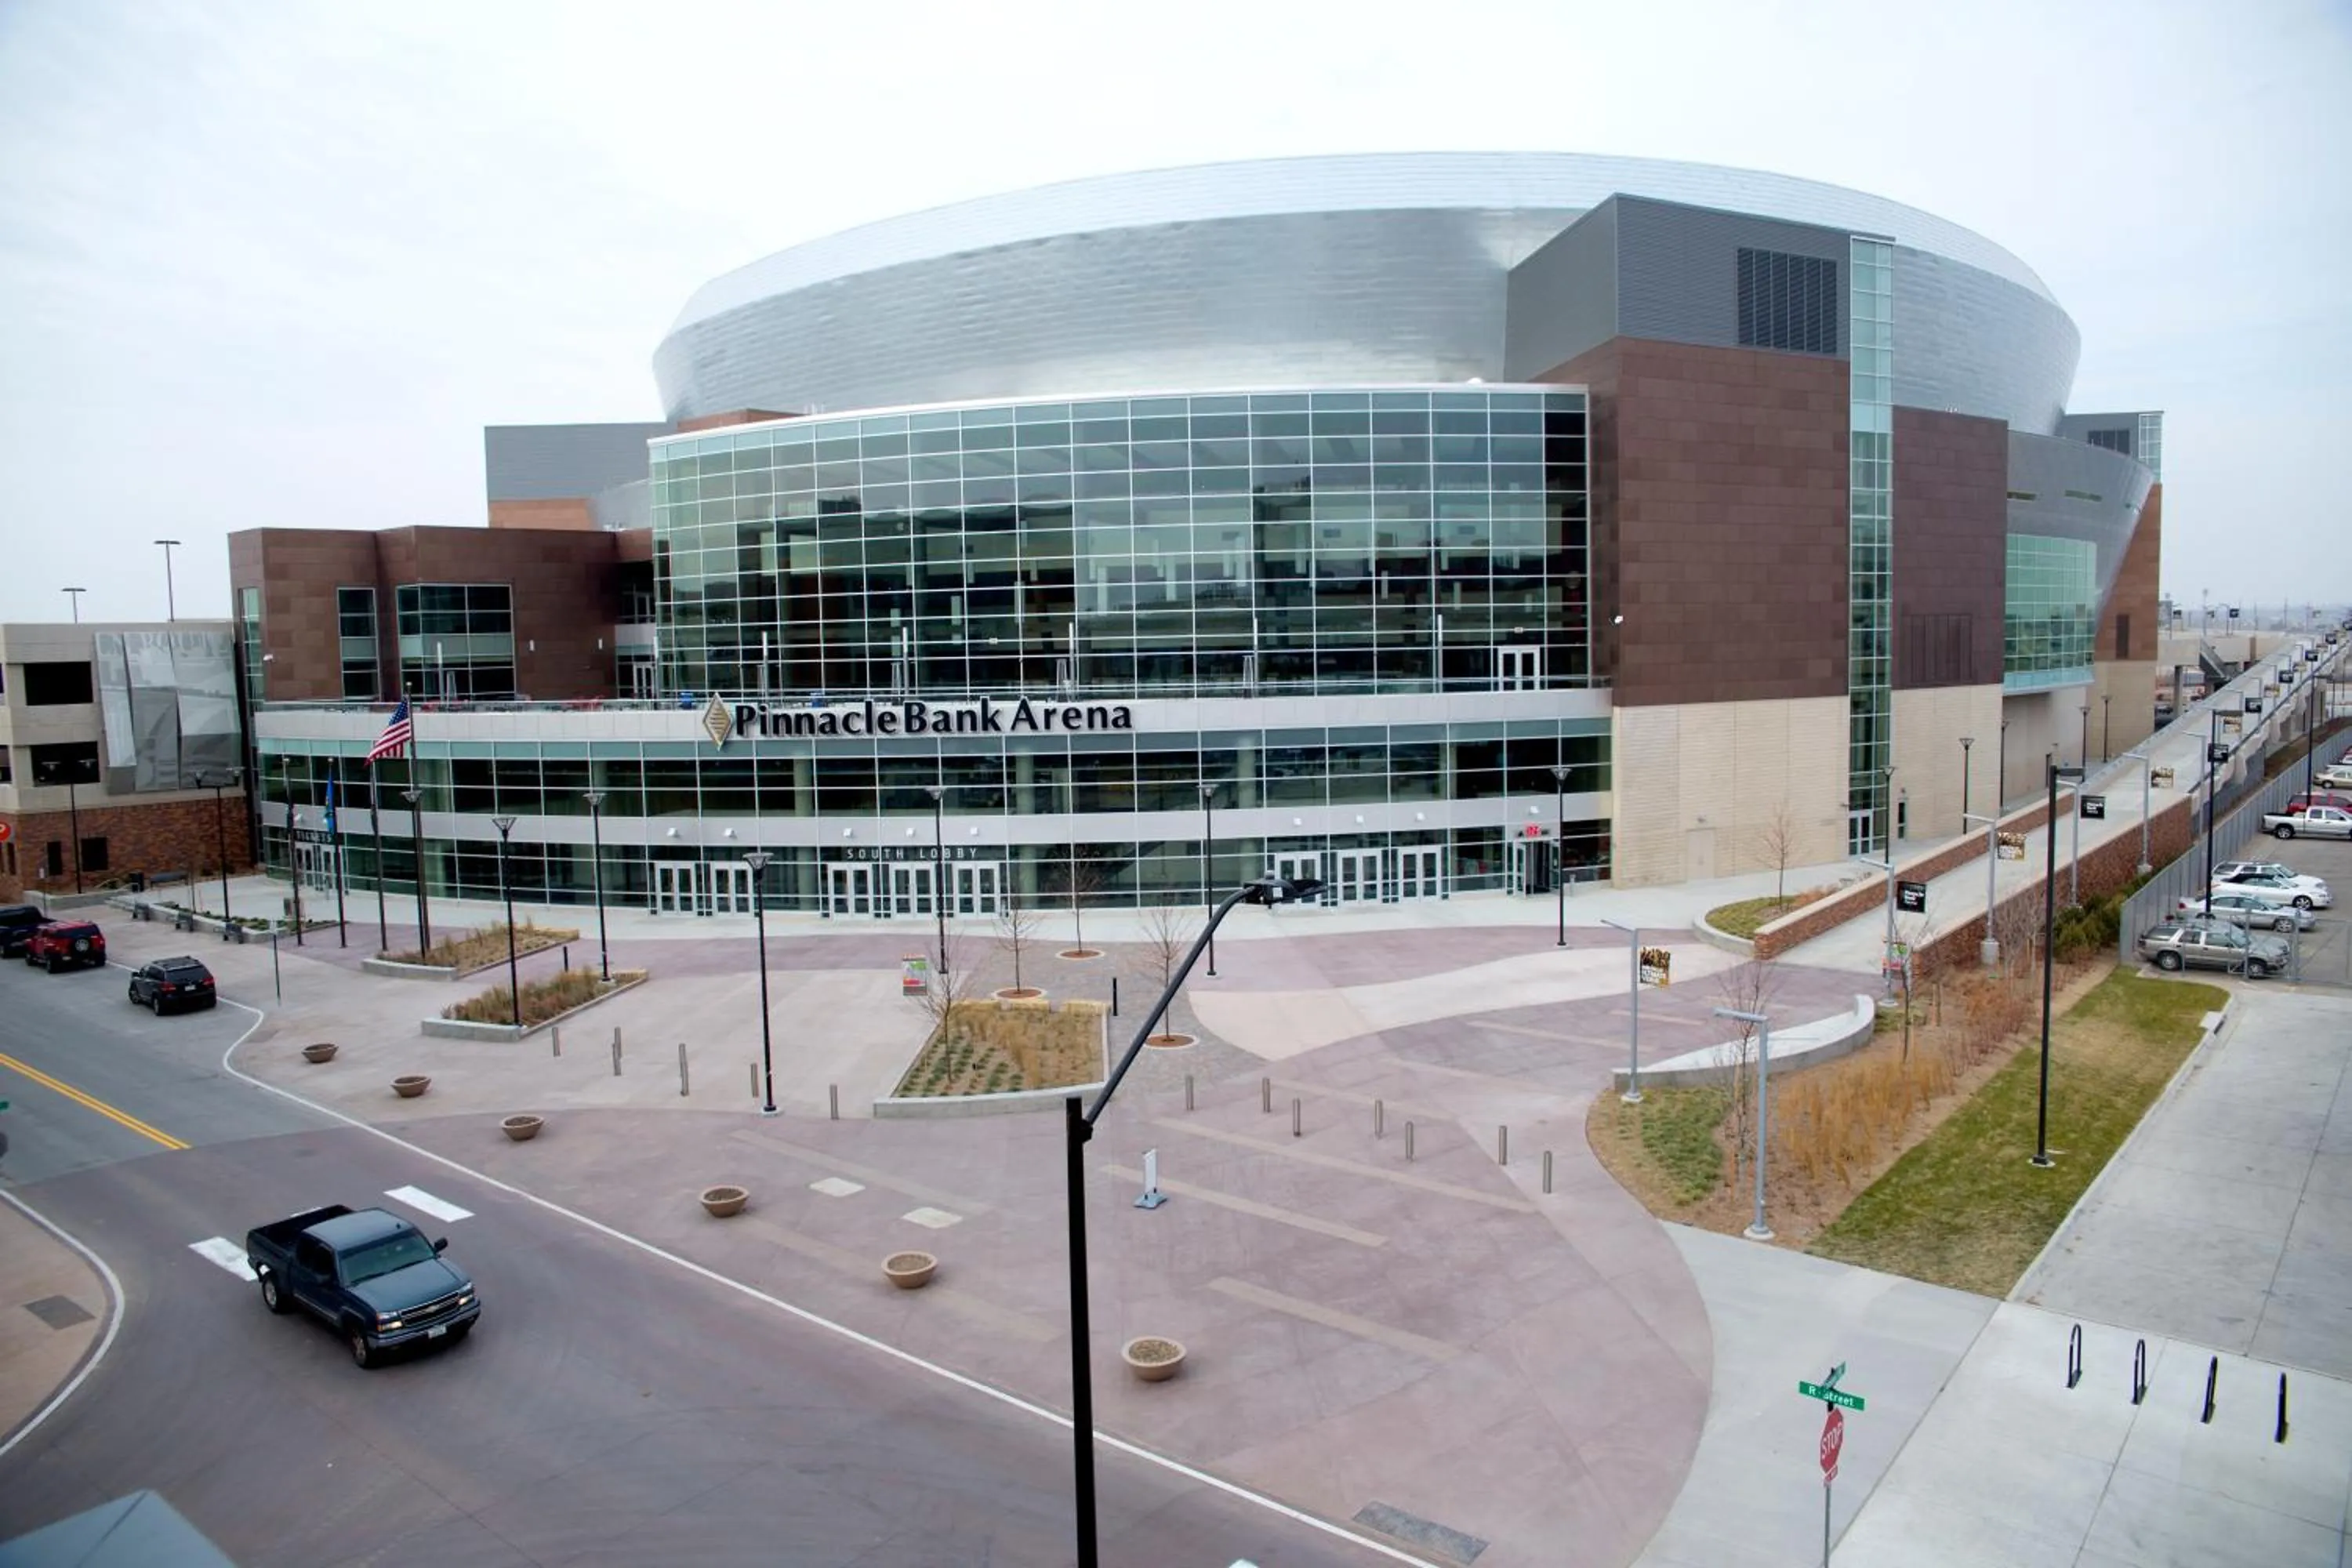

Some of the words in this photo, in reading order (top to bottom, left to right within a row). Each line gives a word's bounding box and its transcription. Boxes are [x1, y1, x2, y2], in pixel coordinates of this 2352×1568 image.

[735, 700, 898, 736] Pinnacle
[904, 697, 1002, 733] Bank
[1011, 697, 1133, 731] Arena
[847, 848, 904, 859] SOUTH
[920, 848, 978, 858] LOBBY
[1809, 1385, 1817, 1396] R
[1821, 1421, 1842, 1459] STOP
